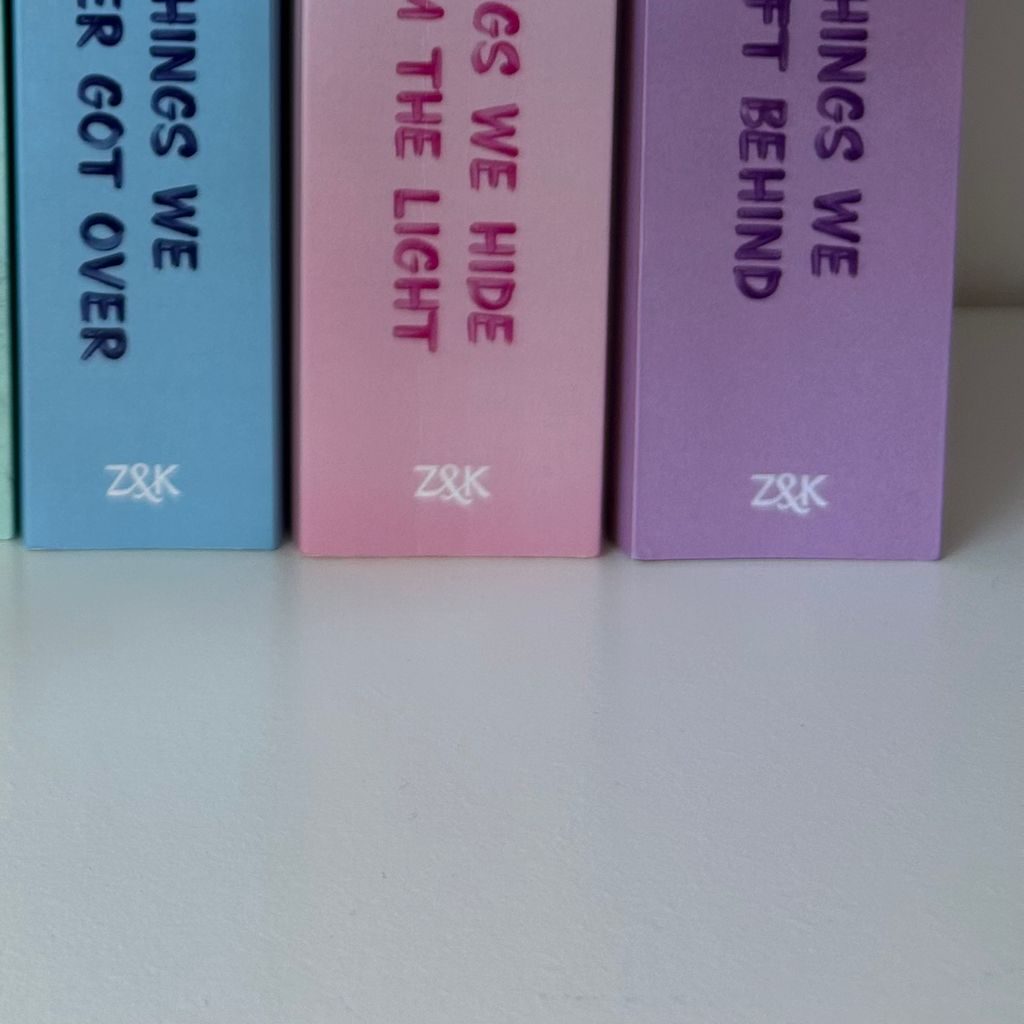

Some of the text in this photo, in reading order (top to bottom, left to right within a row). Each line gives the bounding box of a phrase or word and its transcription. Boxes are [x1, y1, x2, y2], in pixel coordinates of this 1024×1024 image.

[77, 73, 125, 189] GOT
[394, 46, 444, 160] THE
[469, 103, 520, 192] WE
[151, 183, 199, 273] WE
[733, 95, 788, 300] BEHIND
[810, 188, 863, 279] WE
[78, 211, 128, 362] OVER
[392, 188, 441, 354] LIGHT
[466, 221, 517, 345] HIDE
[104, 463, 182, 504] Z&K
[413, 464, 491, 505] Z&K
[750, 473, 829, 514] Z&K
